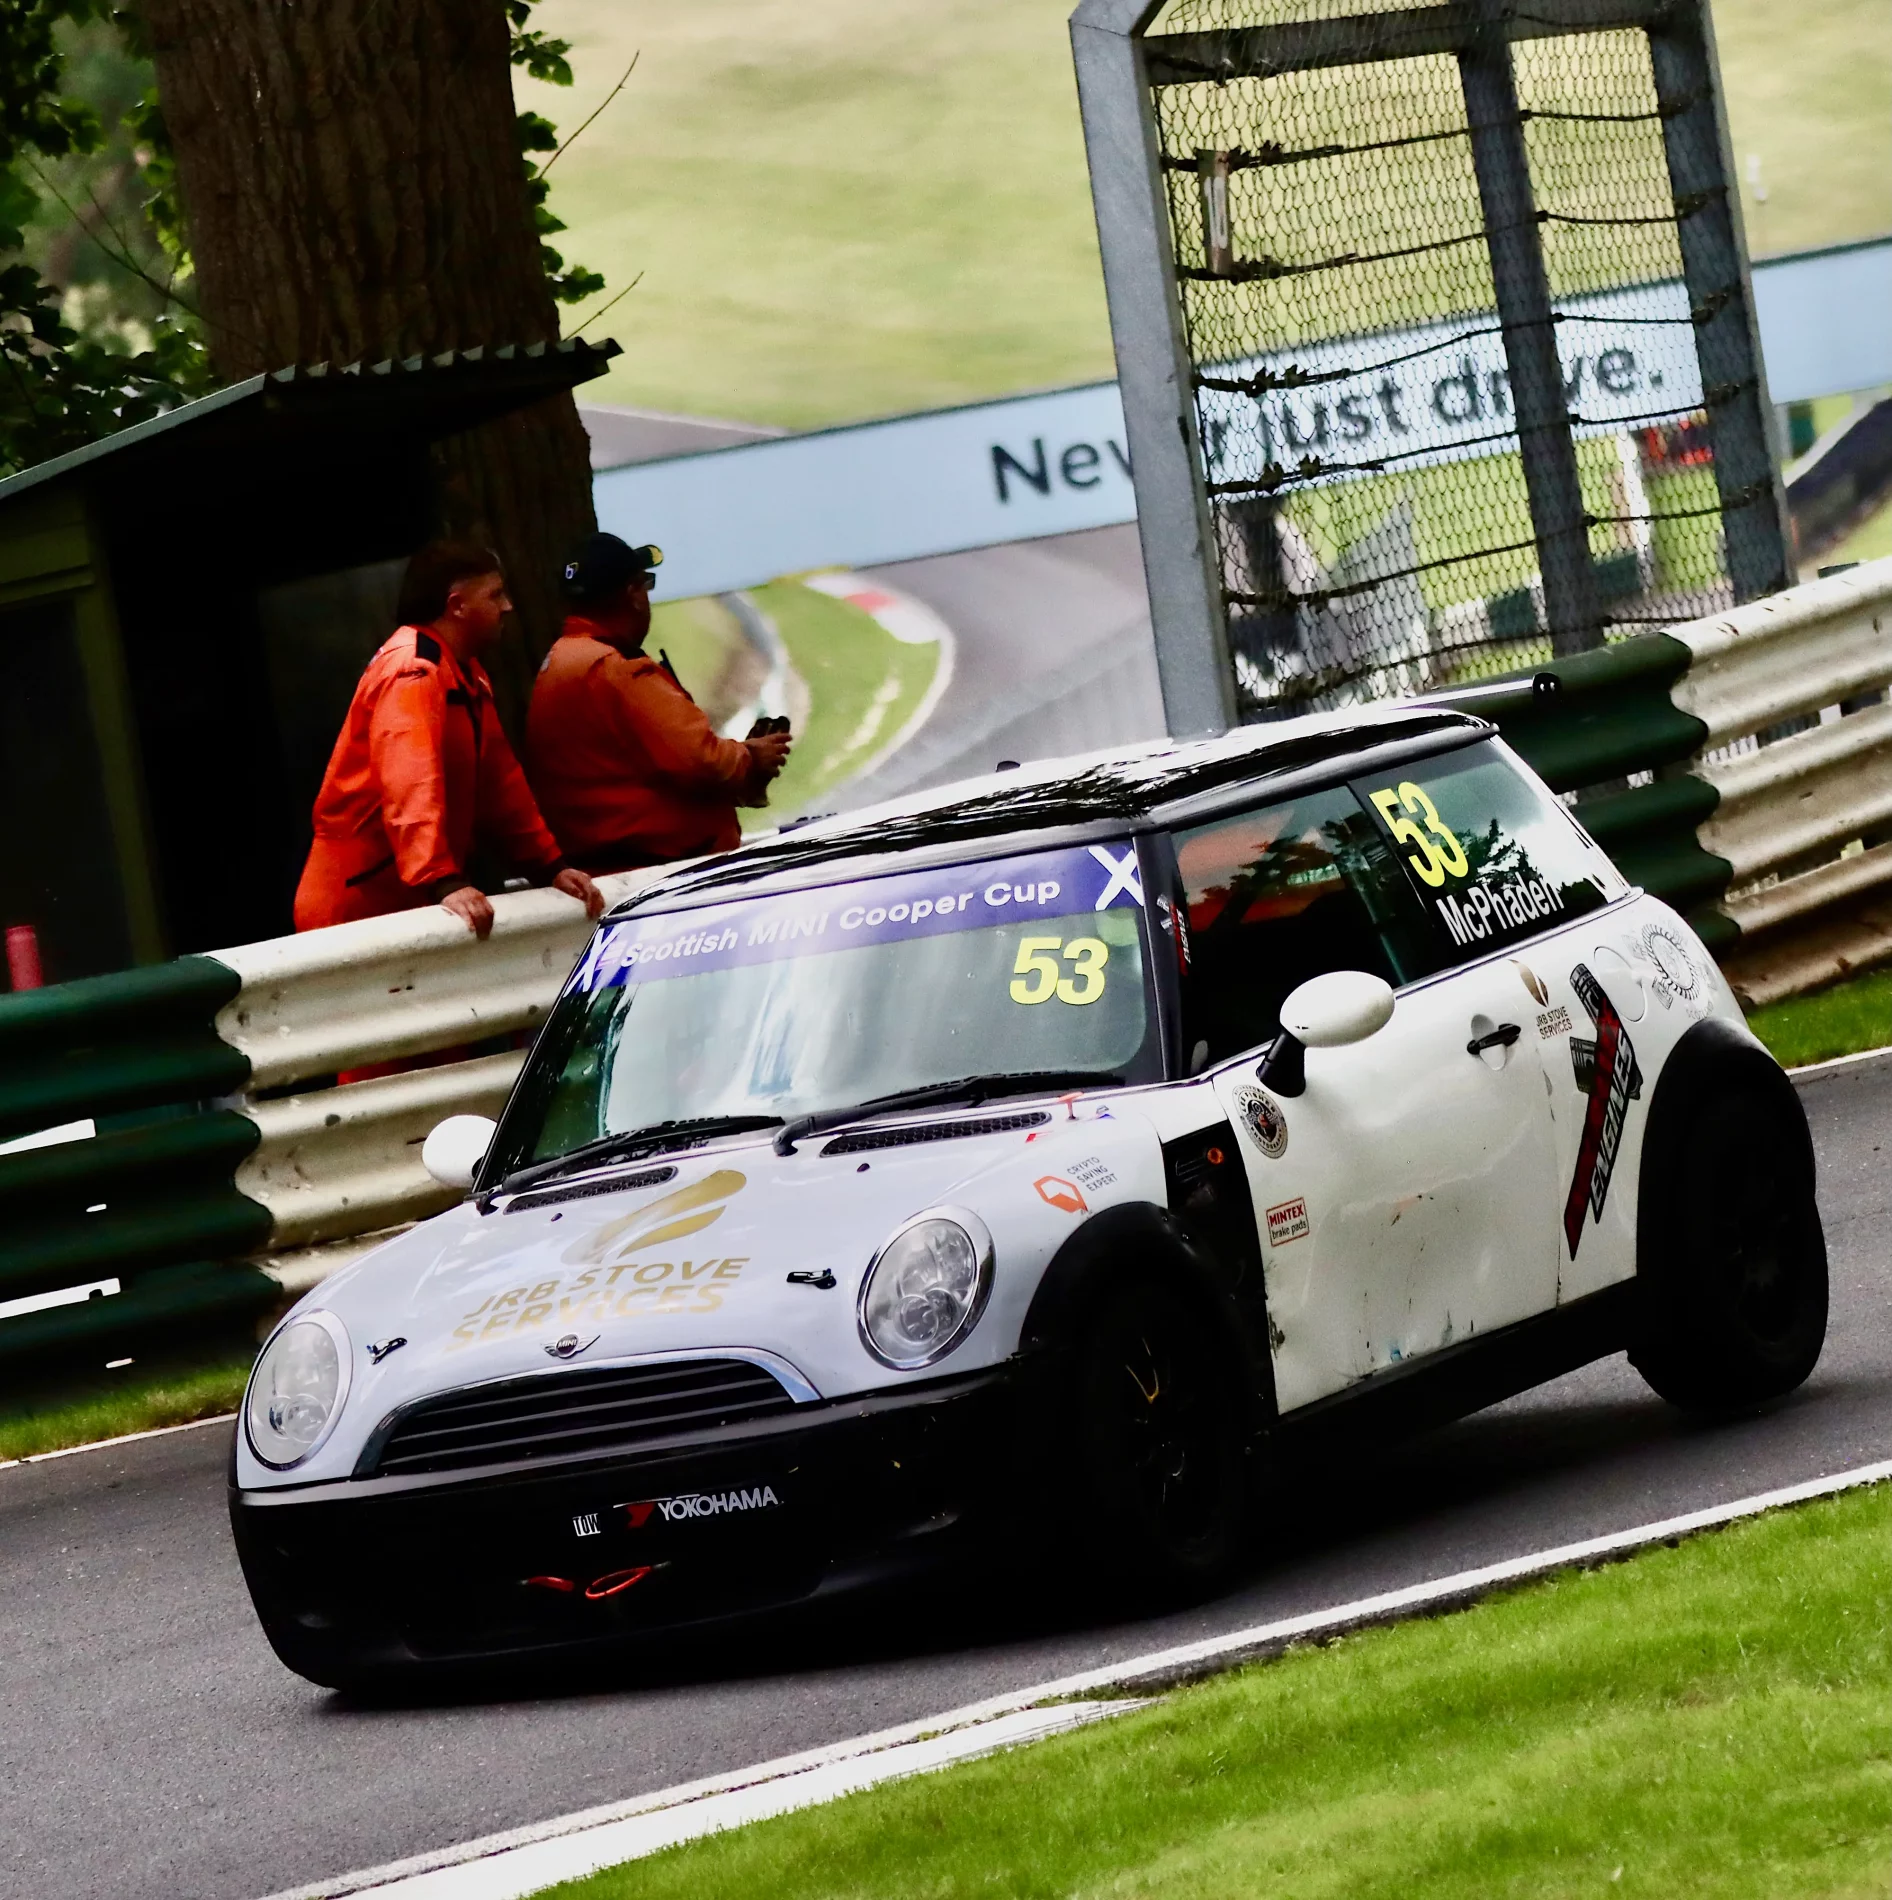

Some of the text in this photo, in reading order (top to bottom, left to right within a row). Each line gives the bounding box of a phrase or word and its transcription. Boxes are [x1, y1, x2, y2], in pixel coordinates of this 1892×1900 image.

[991, 419, 1228, 504] Ner
[1433, 346, 1664, 424] dre.
[1369, 781, 1469, 888] 53
[620, 879, 1061, 968] Scottish MINI Cooper Cup
[1436, 872, 1565, 946] McPhaden
[1009, 936, 1109, 1007] 53
[1536, 1006, 1569, 1027] JRB STOVE
[1539, 1018, 1573, 1040] SERVICES
[1590, 1026, 1633, 1205] ENGINES
[1067, 1156, 1101, 1175] CRYPTO
[1076, 1165, 1109, 1183] SAVING
[1085, 1173, 1119, 1192] EXPERT
[1269, 1204, 1304, 1227] MINTEX
[1272, 1219, 1307, 1240] brake pads
[463, 1257, 751, 1320] JRB STOVE
[449, 1282, 731, 1349] SERVICES
[558, 1338, 578, 1348] MINI
[658, 1485, 779, 1521] YOKOHAMA
[573, 1513, 601, 1536] TOW
